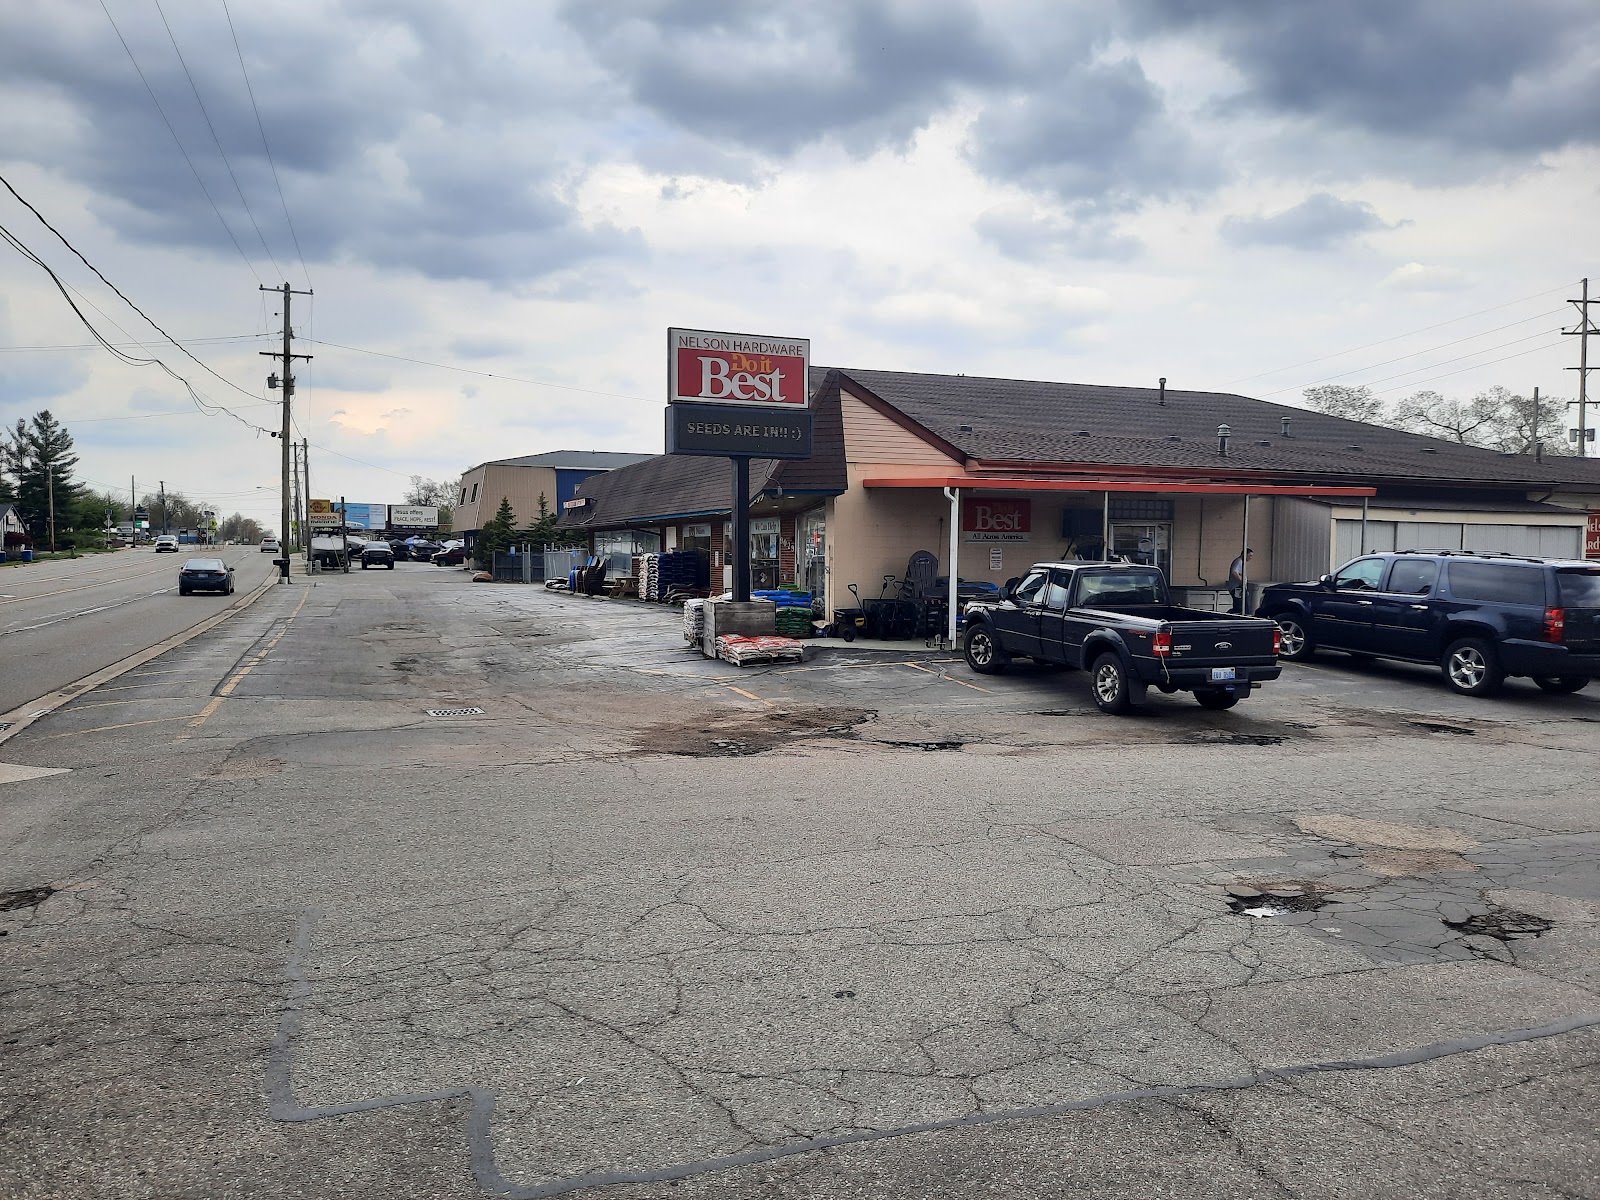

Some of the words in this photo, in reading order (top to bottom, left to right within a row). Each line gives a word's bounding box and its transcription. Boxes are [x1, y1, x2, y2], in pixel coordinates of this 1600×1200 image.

[679, 335, 730, 351] NELSON
[733, 340, 803, 356] HARDWARE
[730, 353, 758, 372] Do
[759, 356, 773, 373] it
[697, 356, 787, 401] Best
[687, 422, 731, 435] SEEDS
[734, 424, 760, 437] ARE
[762, 426, 788, 438] IN!!
[975, 505, 1022, 530] Best
[972, 532, 981, 540] All
